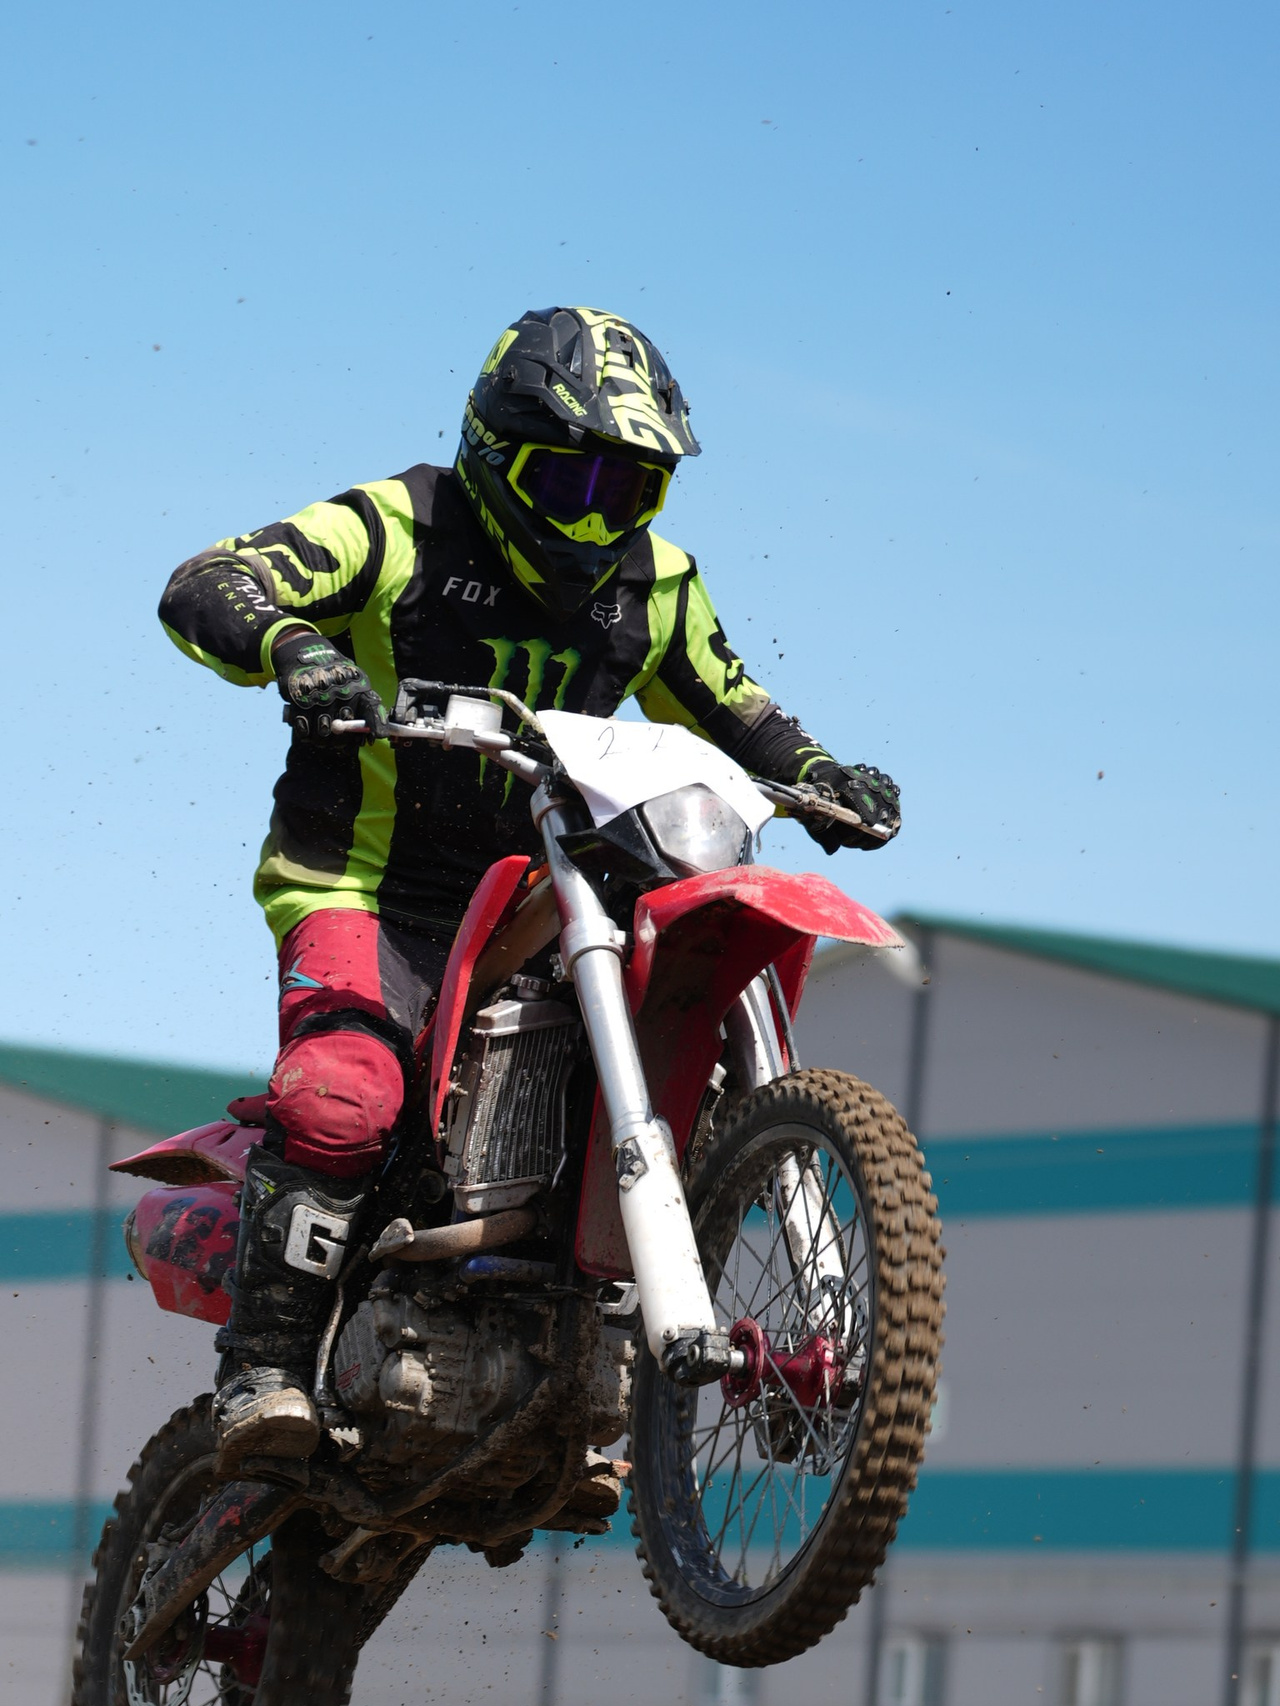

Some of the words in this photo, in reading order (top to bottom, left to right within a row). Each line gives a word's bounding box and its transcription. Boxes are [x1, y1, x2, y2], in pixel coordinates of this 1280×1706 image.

[553, 383, 588, 417] RACING
[217, 582, 258, 630] ENER
[442, 576, 501, 607] FOX
